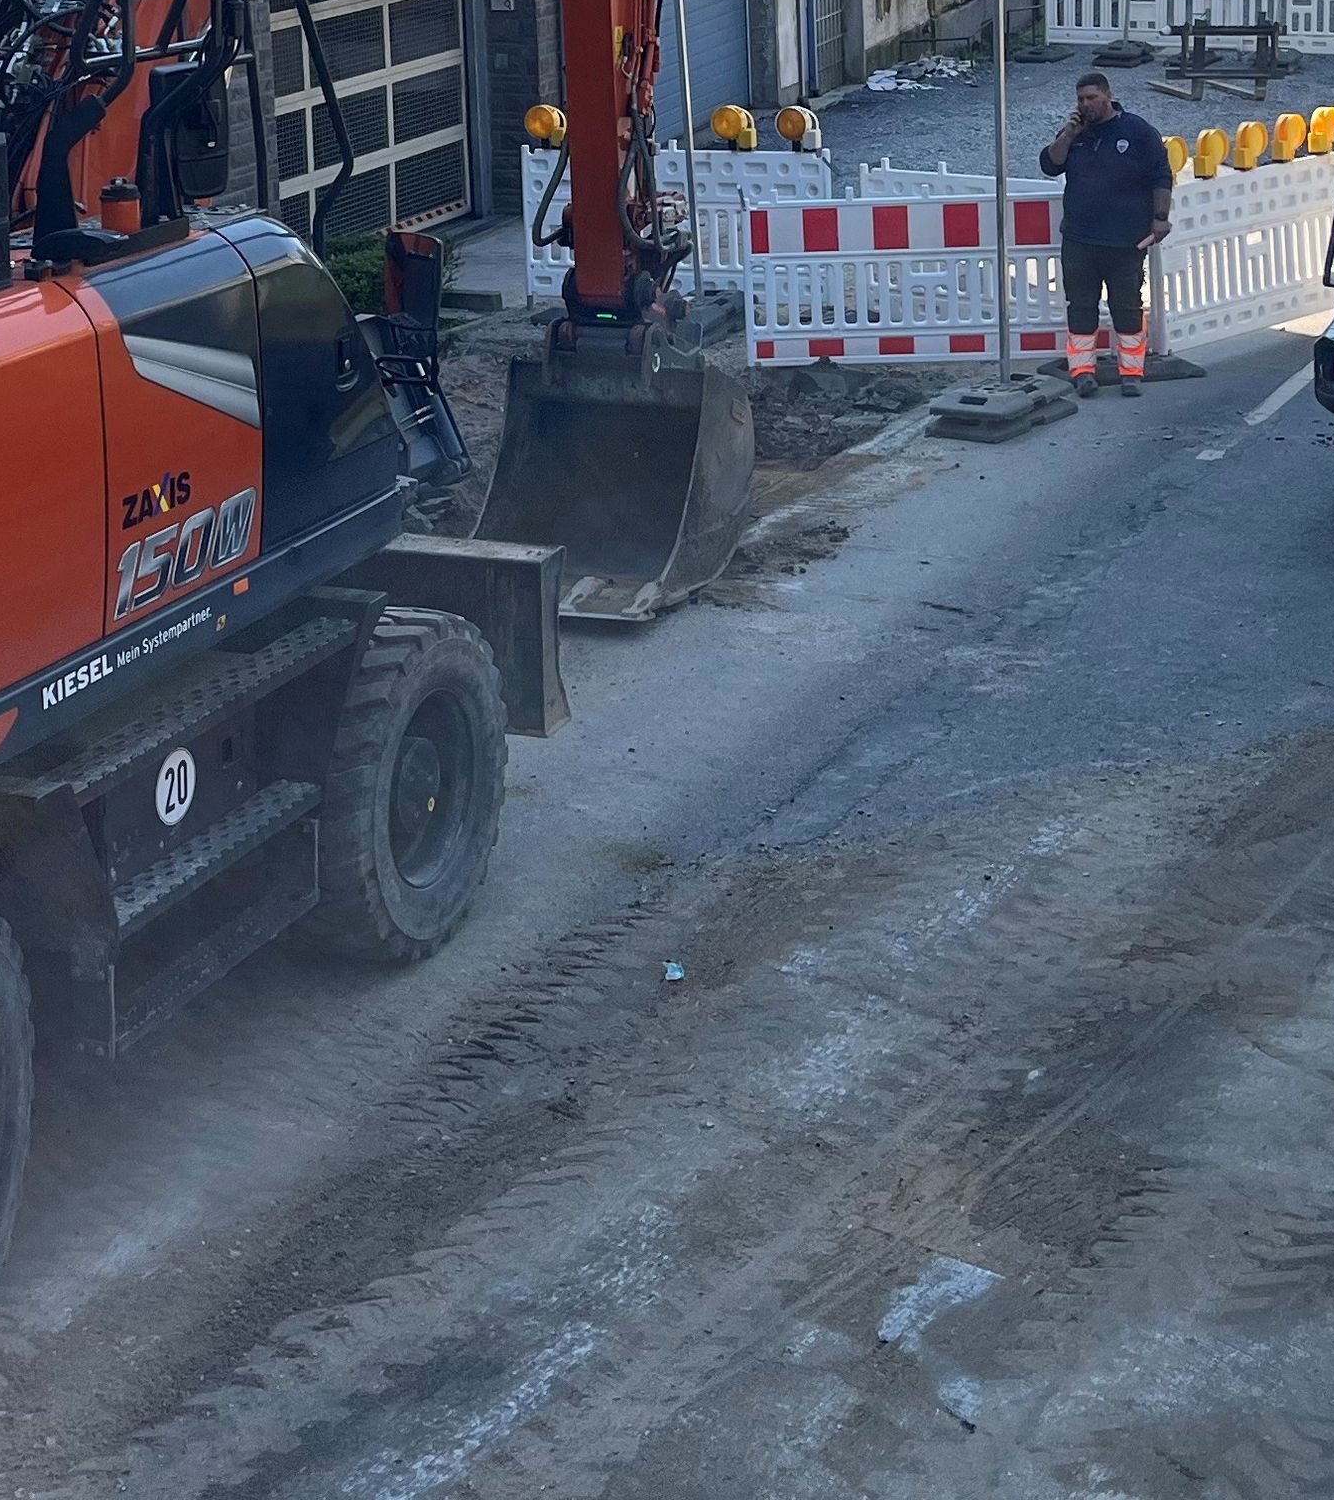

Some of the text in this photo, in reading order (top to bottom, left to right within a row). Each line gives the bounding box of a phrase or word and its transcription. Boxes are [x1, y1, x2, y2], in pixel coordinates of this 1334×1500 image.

[121, 471, 192, 530] ZAXIS
[113, 486, 258, 622] 150W
[42, 606, 212, 710] KIESEL Mein Systempartner.
[164, 760, 188, 815] 20
